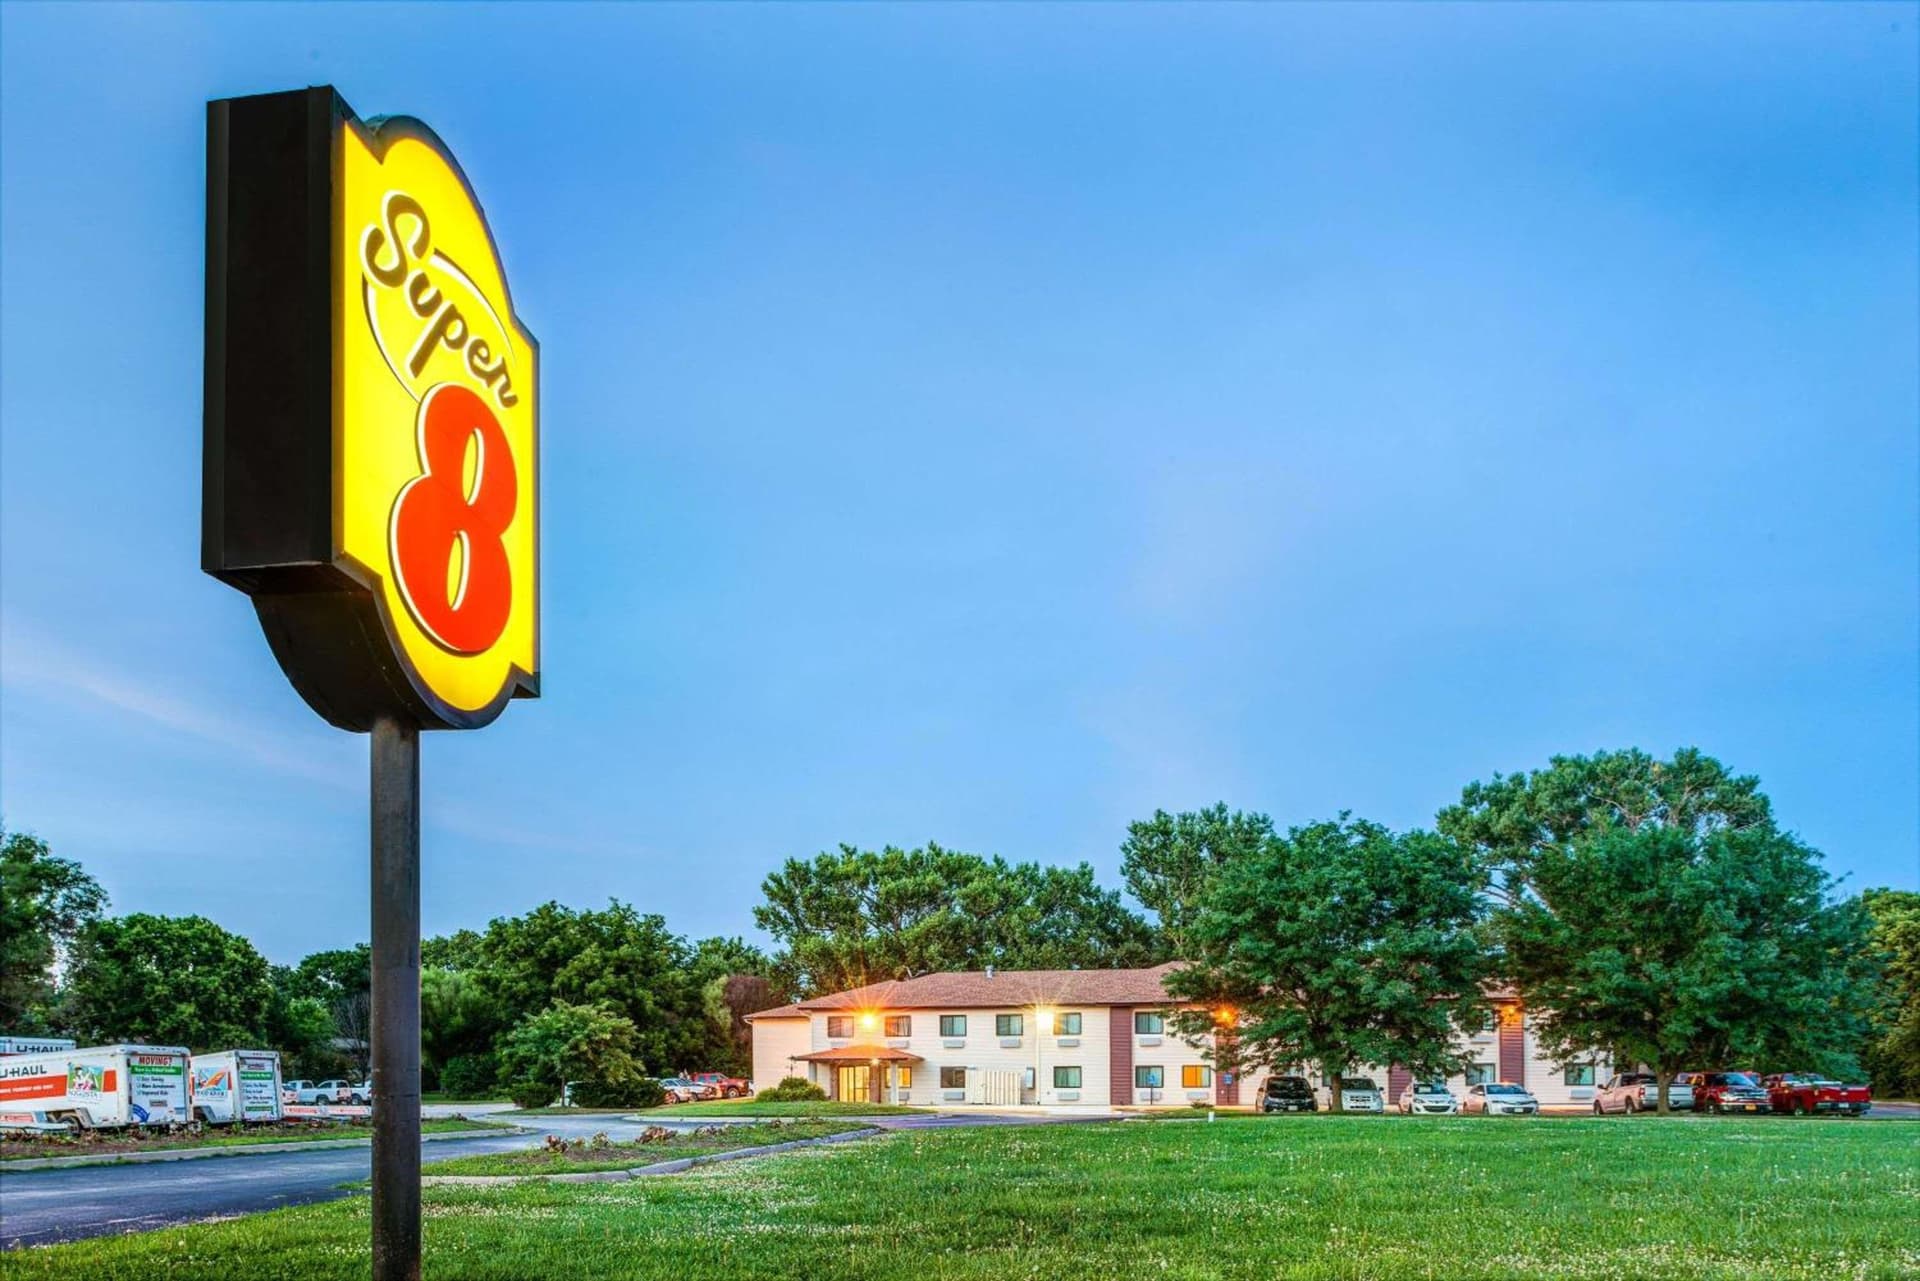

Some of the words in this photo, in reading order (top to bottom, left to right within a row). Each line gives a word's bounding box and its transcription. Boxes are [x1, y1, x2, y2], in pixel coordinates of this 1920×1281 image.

[360, 190, 519, 409] Super
[387, 381, 517, 656] 8
[138, 1056, 172, 1066] MOVING?
